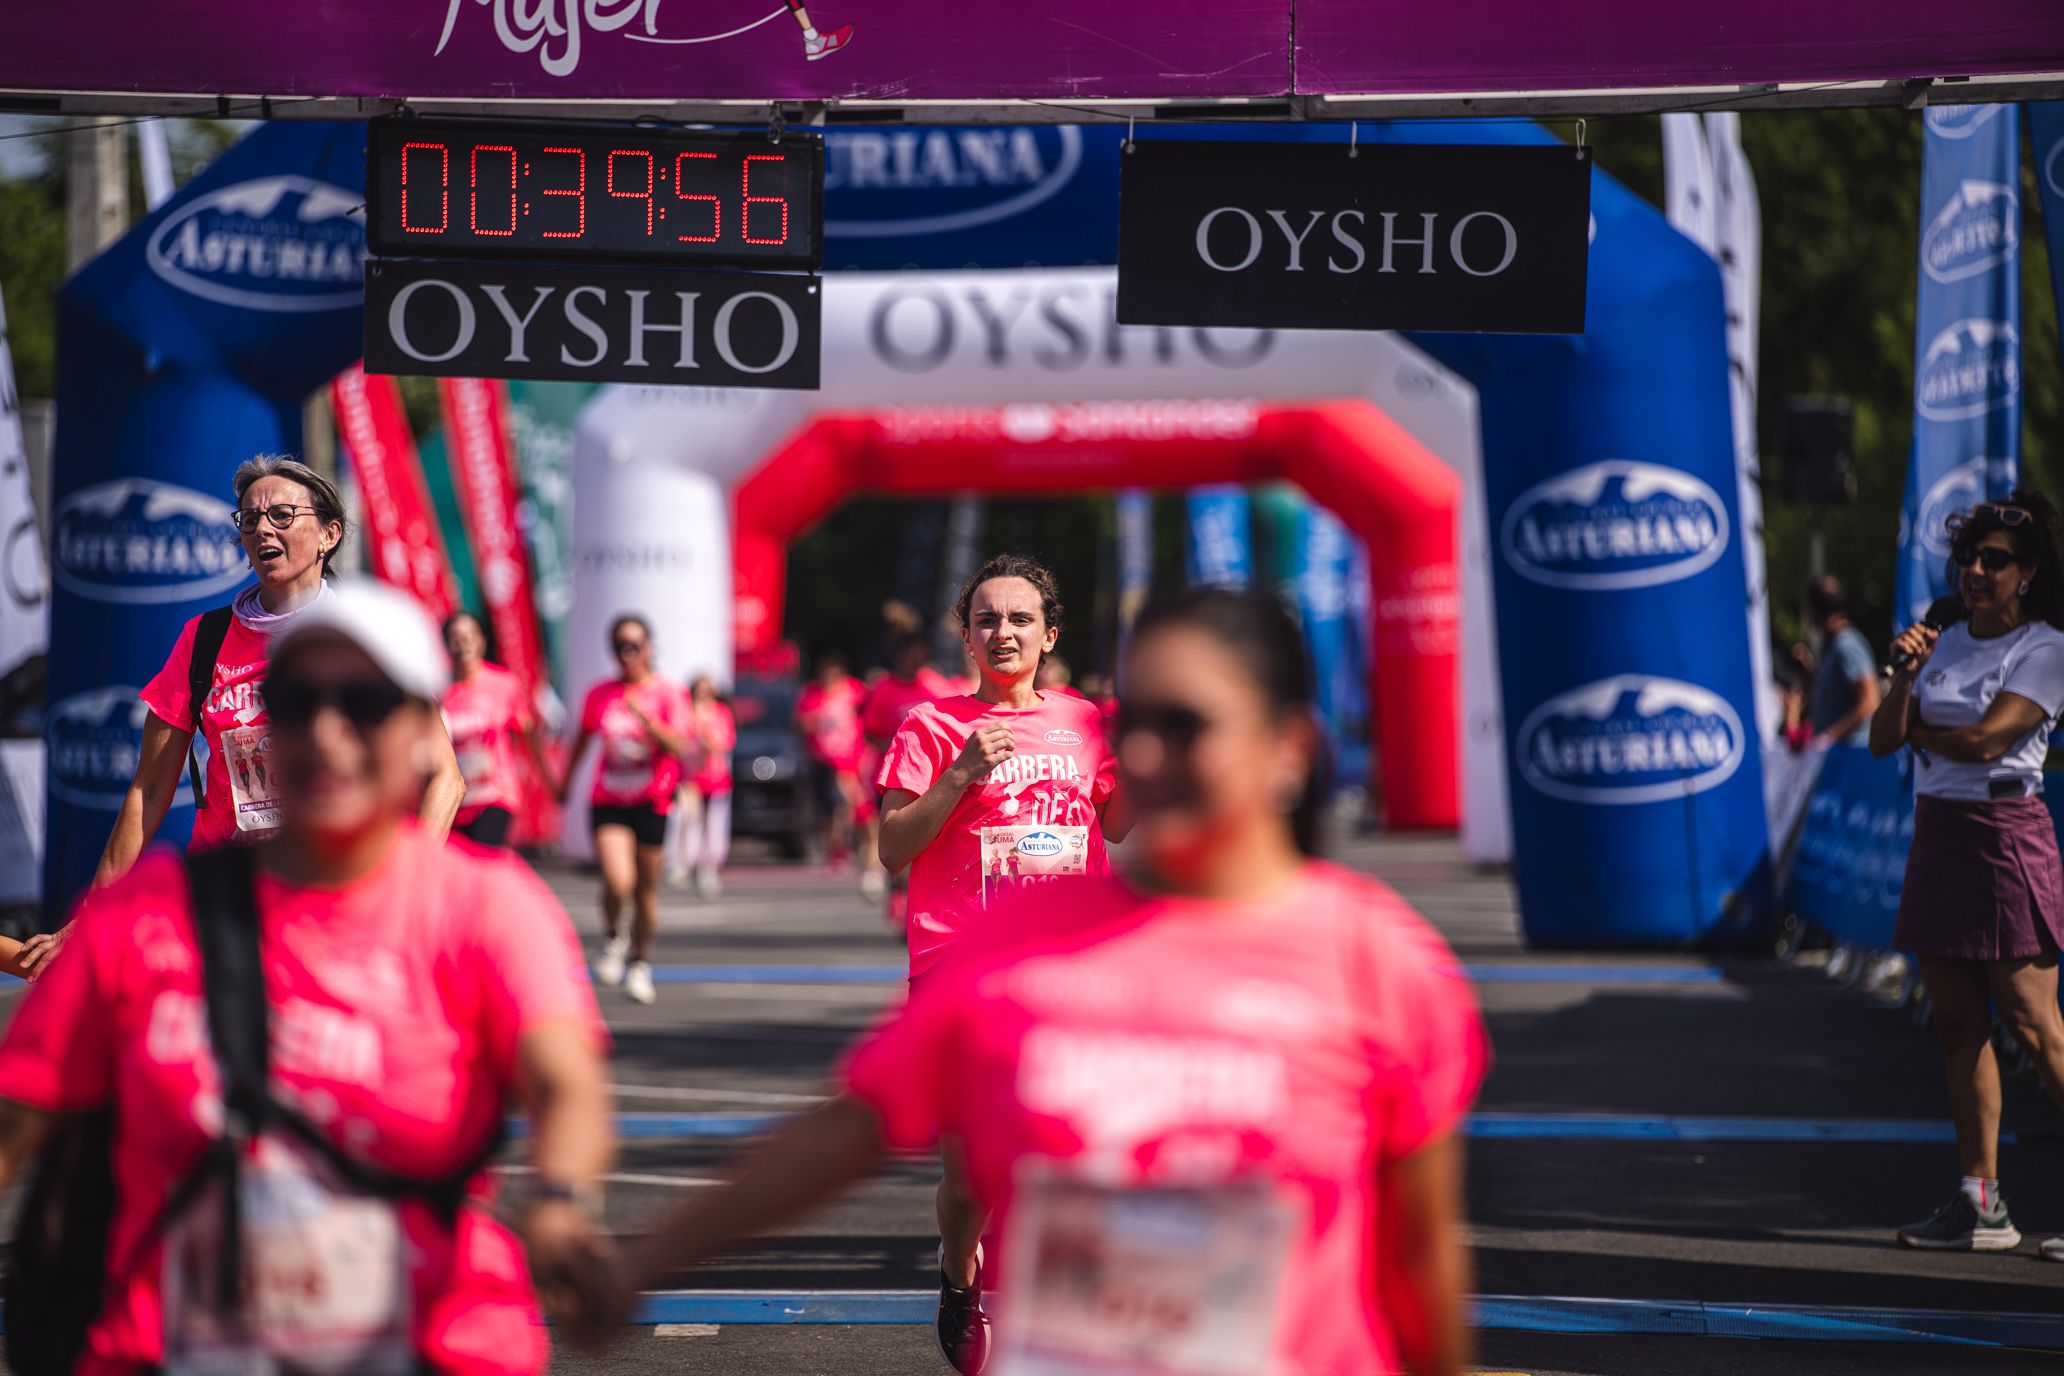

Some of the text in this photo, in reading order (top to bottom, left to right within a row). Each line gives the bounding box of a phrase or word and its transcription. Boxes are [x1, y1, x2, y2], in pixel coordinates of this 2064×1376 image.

[401, 141, 788, 245] 00:39:56
[1195, 207, 1518, 277] OYSHO
[387, 278, 800, 374] OYSHO
[216, 663, 253, 676] YSHO
[206, 680, 268, 714] CARR
[976, 754, 1081, 786] ARRERA
[240, 802, 266, 812] CARRERA
[1020, 840, 1061, 851] ASTURIANA
